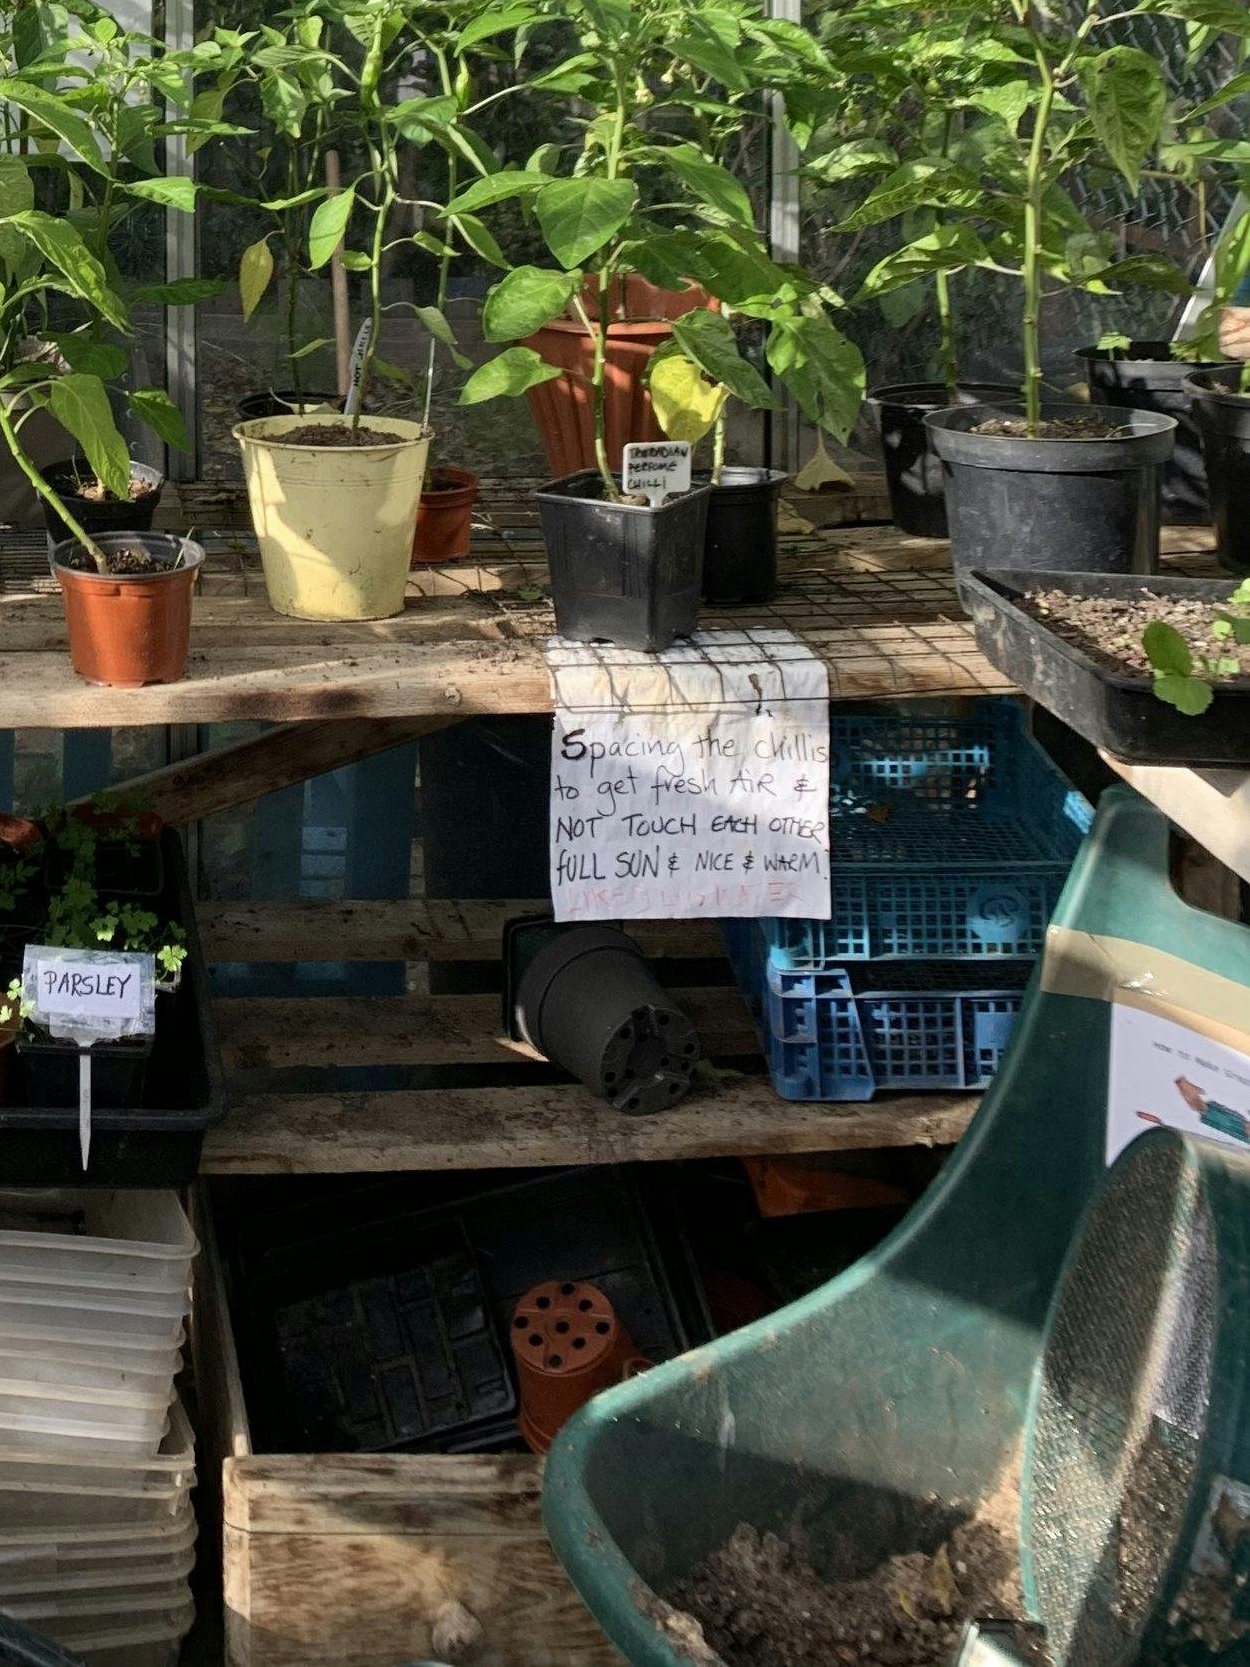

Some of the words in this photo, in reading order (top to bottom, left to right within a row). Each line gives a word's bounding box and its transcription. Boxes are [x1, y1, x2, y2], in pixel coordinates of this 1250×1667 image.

[561, 729, 685, 778] Spacing
[694, 729, 742, 759] the
[555, 775, 579, 802] to
[598, 766, 639, 817] get
[651, 765, 718, 806] fresh
[556, 816, 604, 844] NOT
[622, 813, 696, 837] TOUCH
[711, 814, 758, 835] EACH
[768, 818, 825, 845] OTHER
[614, 845, 660, 879] SUN
[695, 852, 734, 873] NICE
[763, 852, 821, 874] WARM
[44, 970, 132, 999] PARSLEY
